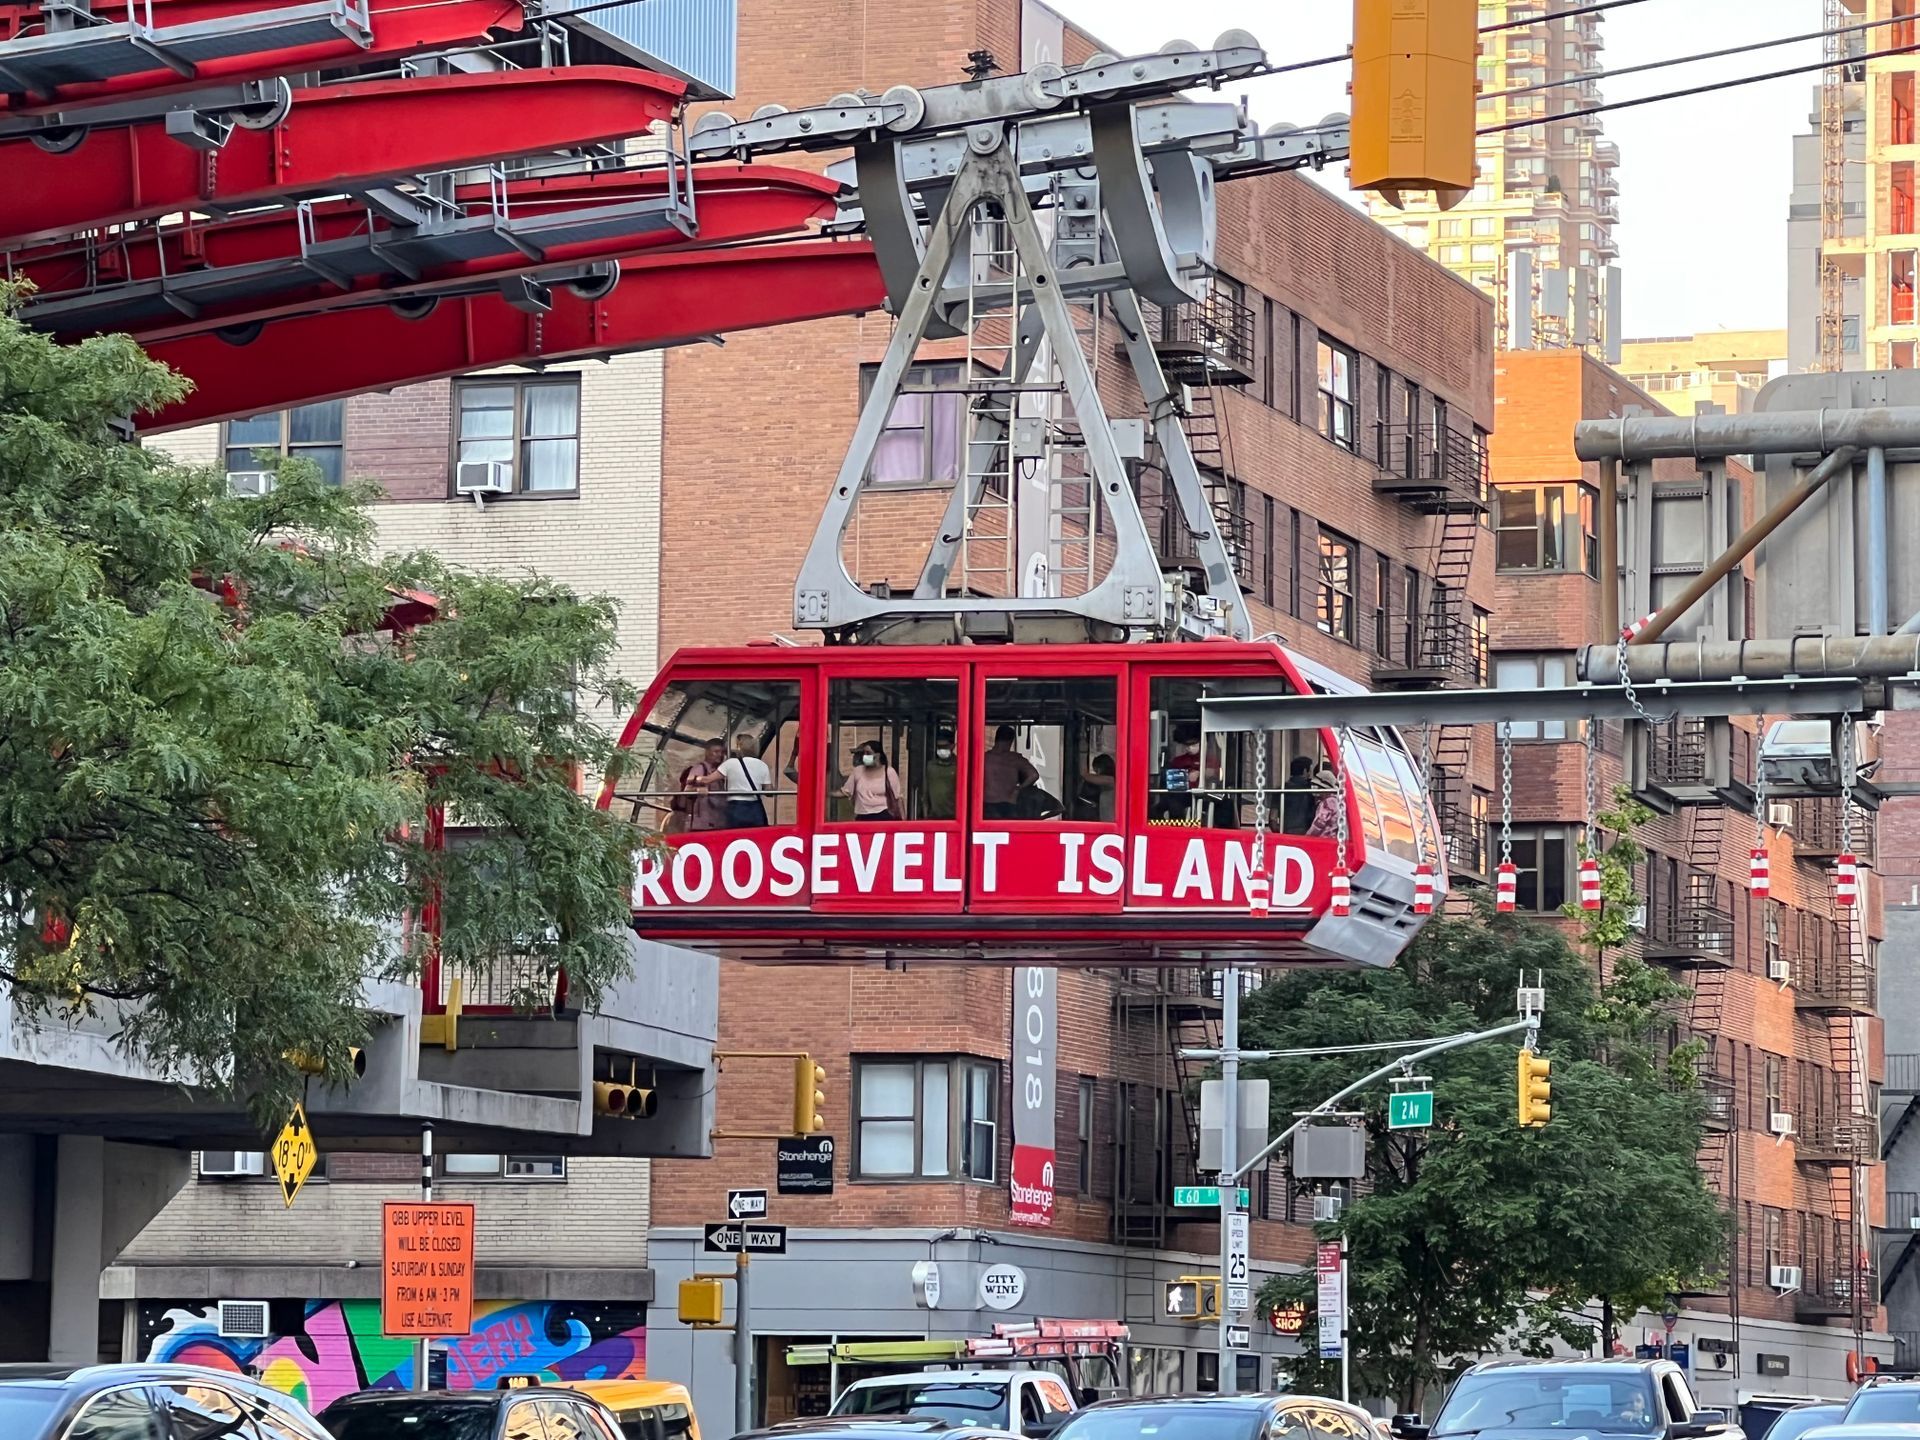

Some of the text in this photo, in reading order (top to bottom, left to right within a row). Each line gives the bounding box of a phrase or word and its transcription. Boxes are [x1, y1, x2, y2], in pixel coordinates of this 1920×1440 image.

[631, 831, 1315, 907] ROOSEVELT ISLAND
[1401, 1100, 1420, 1120] 2 Av
[778, 1150, 832, 1163] Stonehenge
[1011, 1181, 1053, 1212] Stonehenge
[1177, 1189, 1184, 1204] E
[1186, 1189, 1200, 1204] 60
[733, 1199, 763, 1211] ONE WAY
[411, 1211, 439, 1226] UPPER
[441, 1211, 465, 1227] LEVEL
[398, 1236, 462, 1252] WILL BE CLOSED
[716, 1232, 776, 1245] ONE WAY
[391, 1261, 466, 1277] SATURDAY & SUNDAY
[1230, 1252, 1246, 1279] 25
[986, 1274, 1017, 1284] CITY
[396, 1286, 417, 1302] FROM
[426, 1287, 437, 1302] AM
[449, 1287, 460, 1302] PM
[984, 1285, 1019, 1294] WINE
[401, 1312, 453, 1328] USE ALTERNATE
[1275, 1317, 1303, 1330] SHOP
